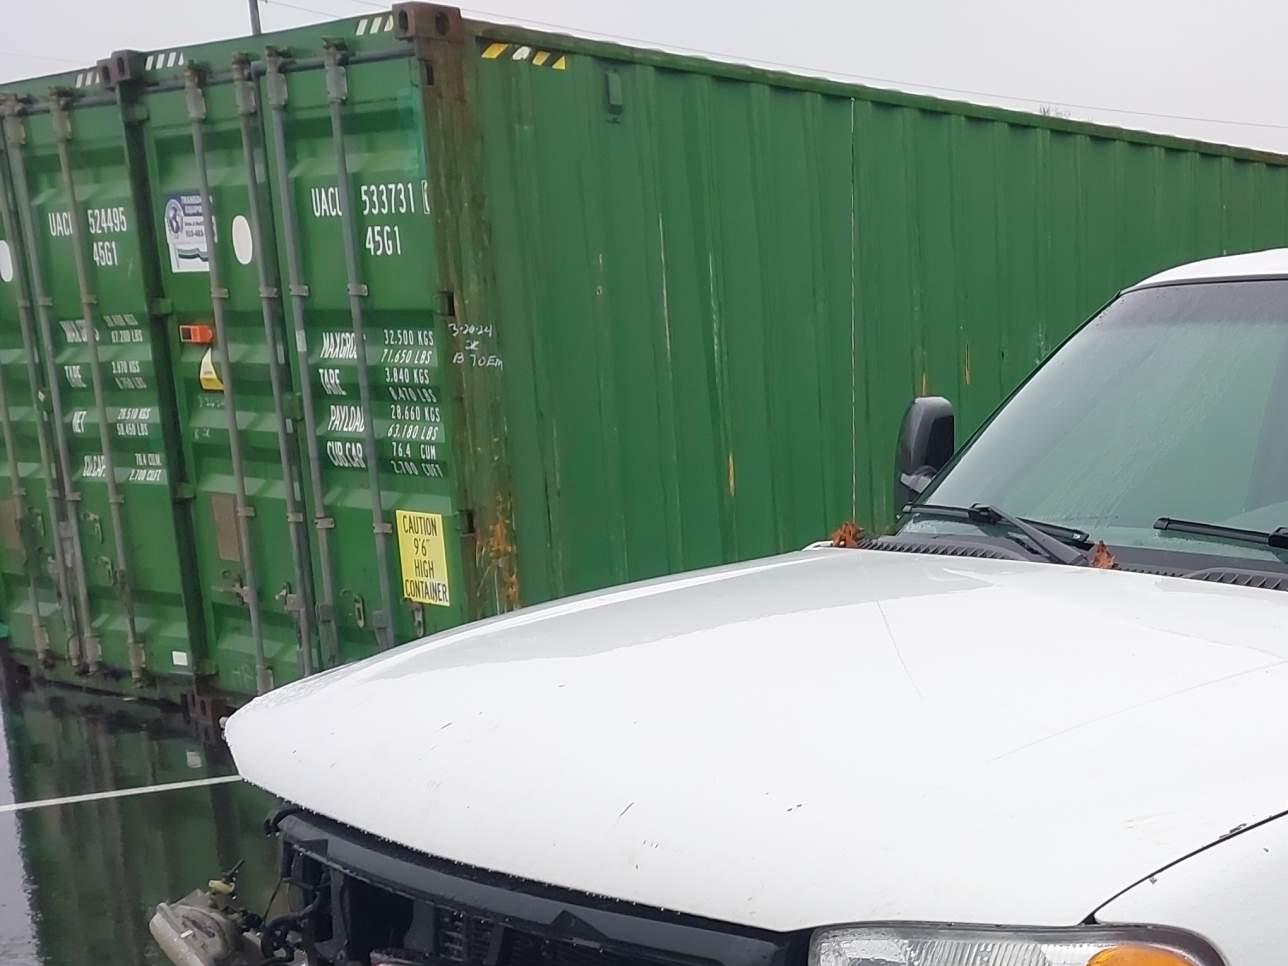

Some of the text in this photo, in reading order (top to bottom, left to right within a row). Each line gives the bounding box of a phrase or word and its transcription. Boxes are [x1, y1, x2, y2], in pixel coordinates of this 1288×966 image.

[360, 182, 415, 216] 533731
[48, 206, 128, 237] UAC 524495
[365, 225, 402, 256] 45G1
[92, 240, 119, 267] 45G1
[319, 329, 434, 360] MAXGRO 32.500 KGS
[380, 348, 433, 364] 71.650 LBS
[318, 367, 430, 396] TARE 3.840 KGS
[391, 404, 420, 420] 28.660
[424, 406, 441, 422] KGS
[387, 423, 439, 441] 63.180 LBS
[391, 441, 412, 458] 76.4
[420, 444, 437, 460] CUM
[390, 460, 419, 476] 2.700
[403, 515, 437, 536] CAUTION
[414, 559, 434, 578] HIGH
[405, 579, 448, 602] CONTAINER
